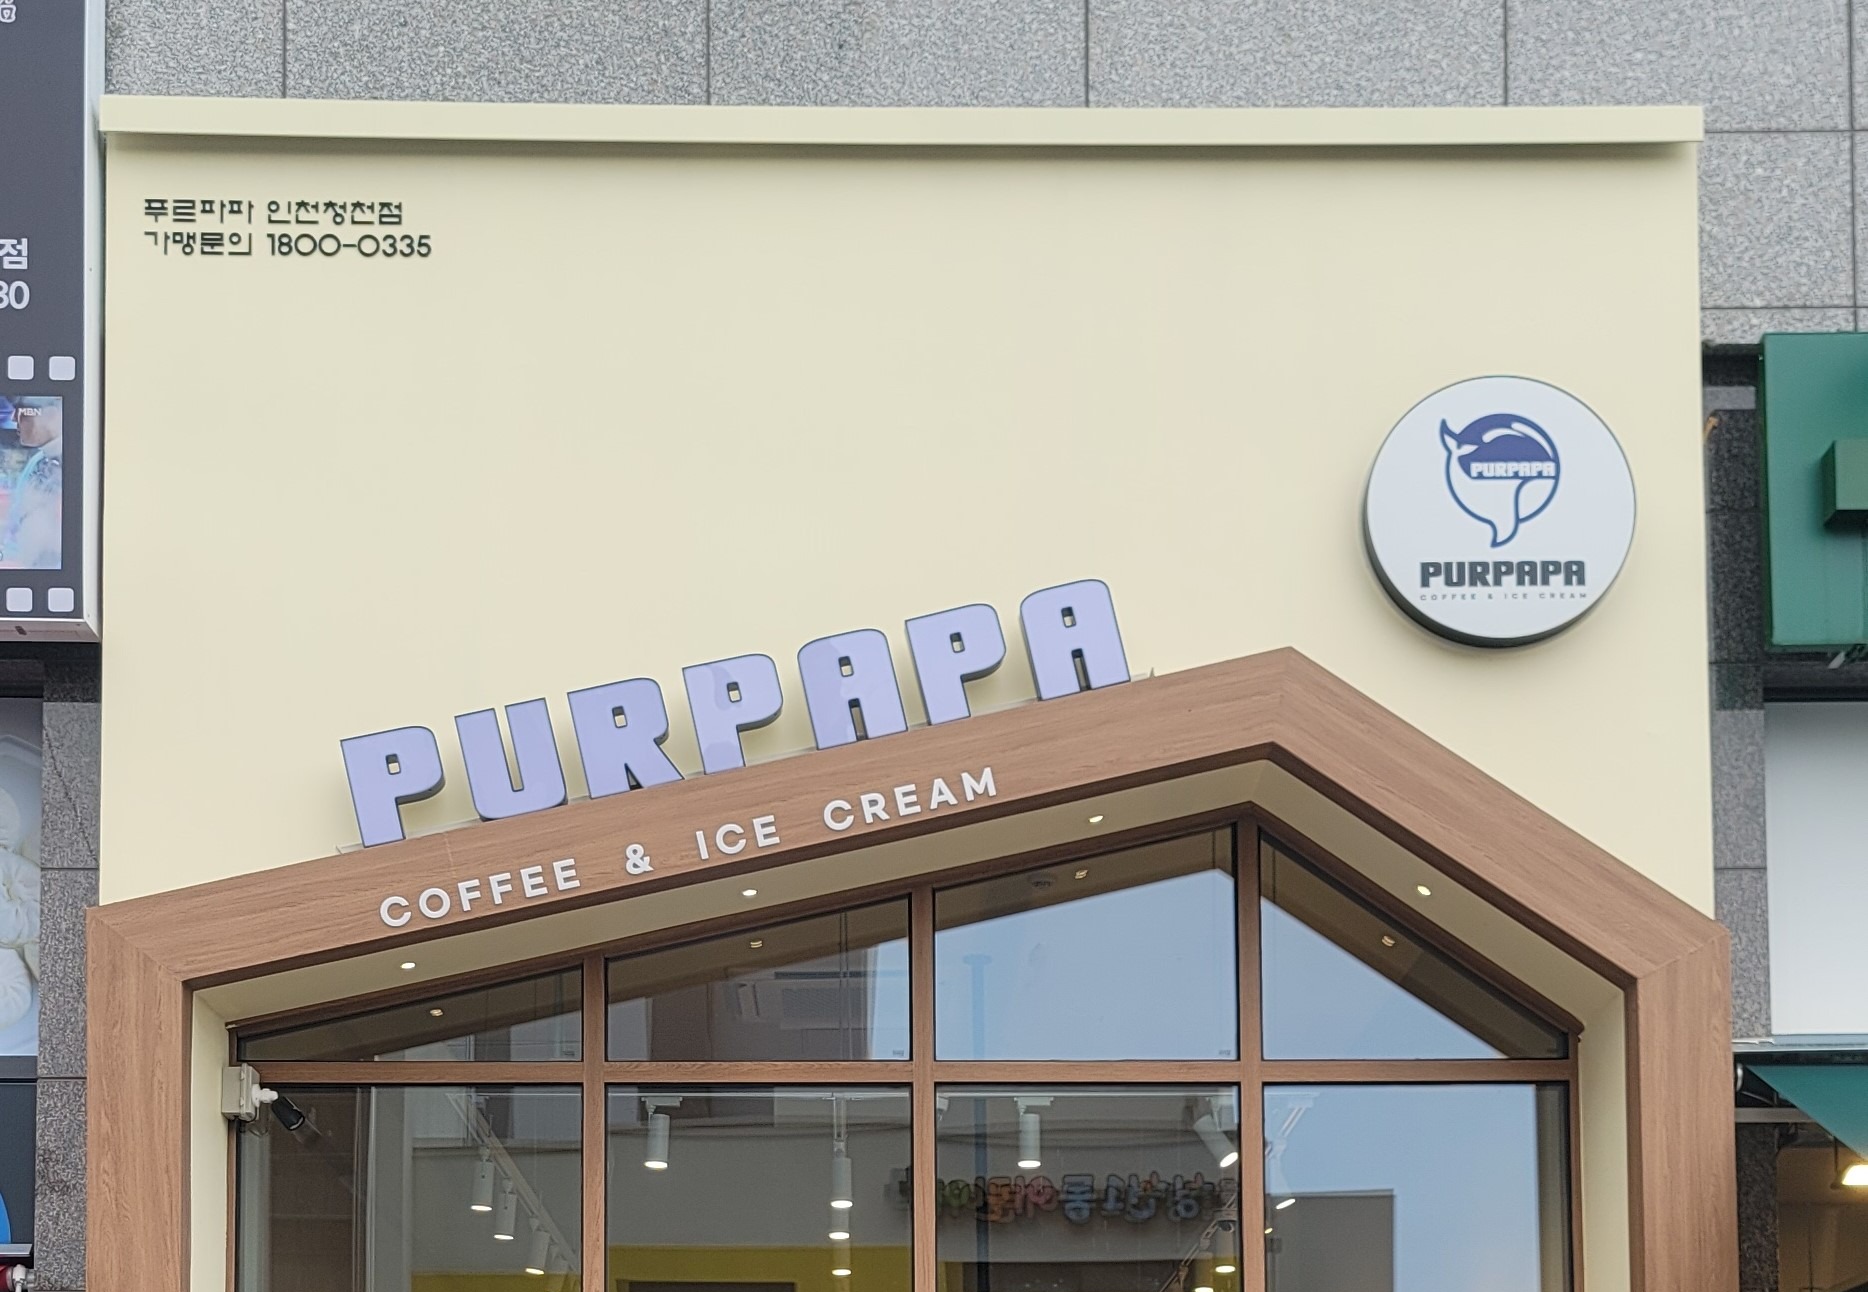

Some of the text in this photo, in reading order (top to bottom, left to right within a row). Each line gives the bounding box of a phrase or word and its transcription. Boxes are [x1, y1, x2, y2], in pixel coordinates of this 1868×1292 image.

[144, 198, 402, 226] 푸르파파 인천청천점
[144, 231, 432, 258] 가맹문의 1800-0335
[1470, 461, 1556, 478] PURPAPA
[1419, 560, 1586, 588] PURPAPA
[1419, 593, 1477, 601] COFFEE
[1504, 592, 1528, 600] ICE
[1538, 592, 1587, 600] CREAM
[340, 578, 1131, 849] PURPAPA
[379, 766, 999, 928] COFFEE & ICE CREAM
